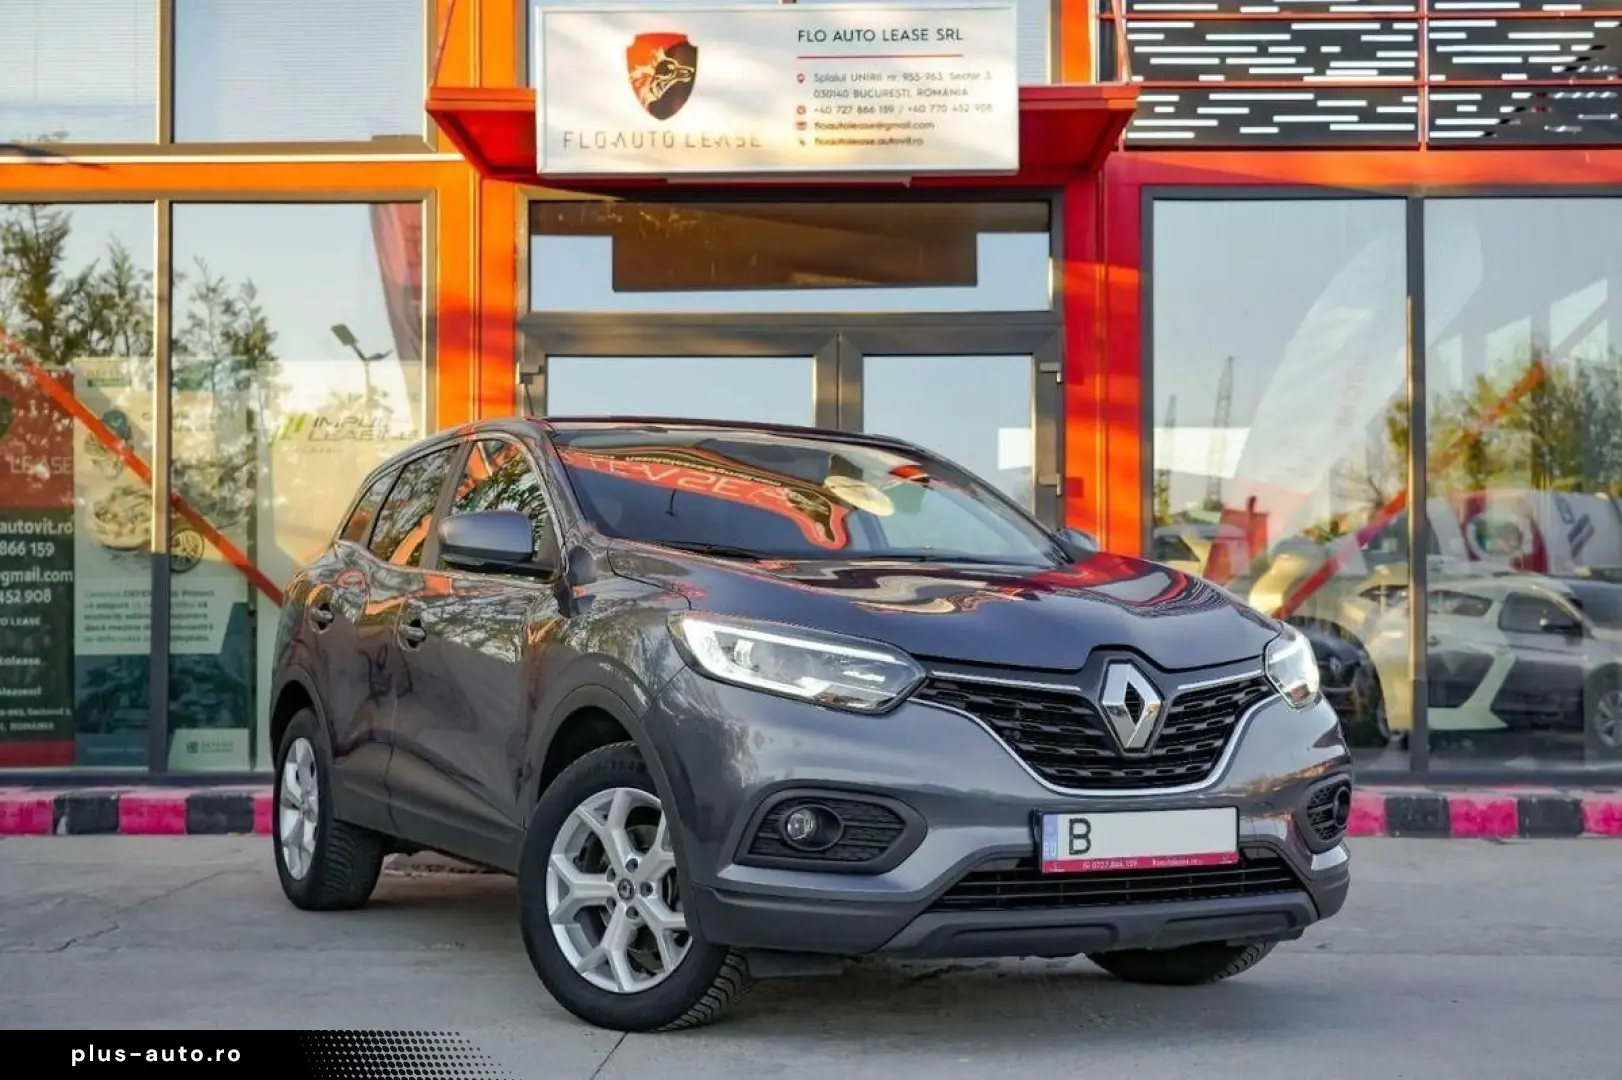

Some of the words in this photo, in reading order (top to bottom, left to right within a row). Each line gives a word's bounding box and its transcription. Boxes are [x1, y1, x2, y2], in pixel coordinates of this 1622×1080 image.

[798, 29, 827, 43] FLO
[833, 29, 876, 42] AUTO
[883, 28, 929, 42] LEASE
[936, 28, 963, 41] SRL
[836, 105, 853, 114] 727
[879, 104, 895, 113] 159
[929, 104, 947, 113] 770
[685, 131, 762, 148] LEASE
[10, 455, 73, 474] LEASE
[30, 541, 55, 557] 159
[24, 588, 52, 604] 908
[11, 617, 41, 626] LEASE
[1068, 817, 1092, 855] B
